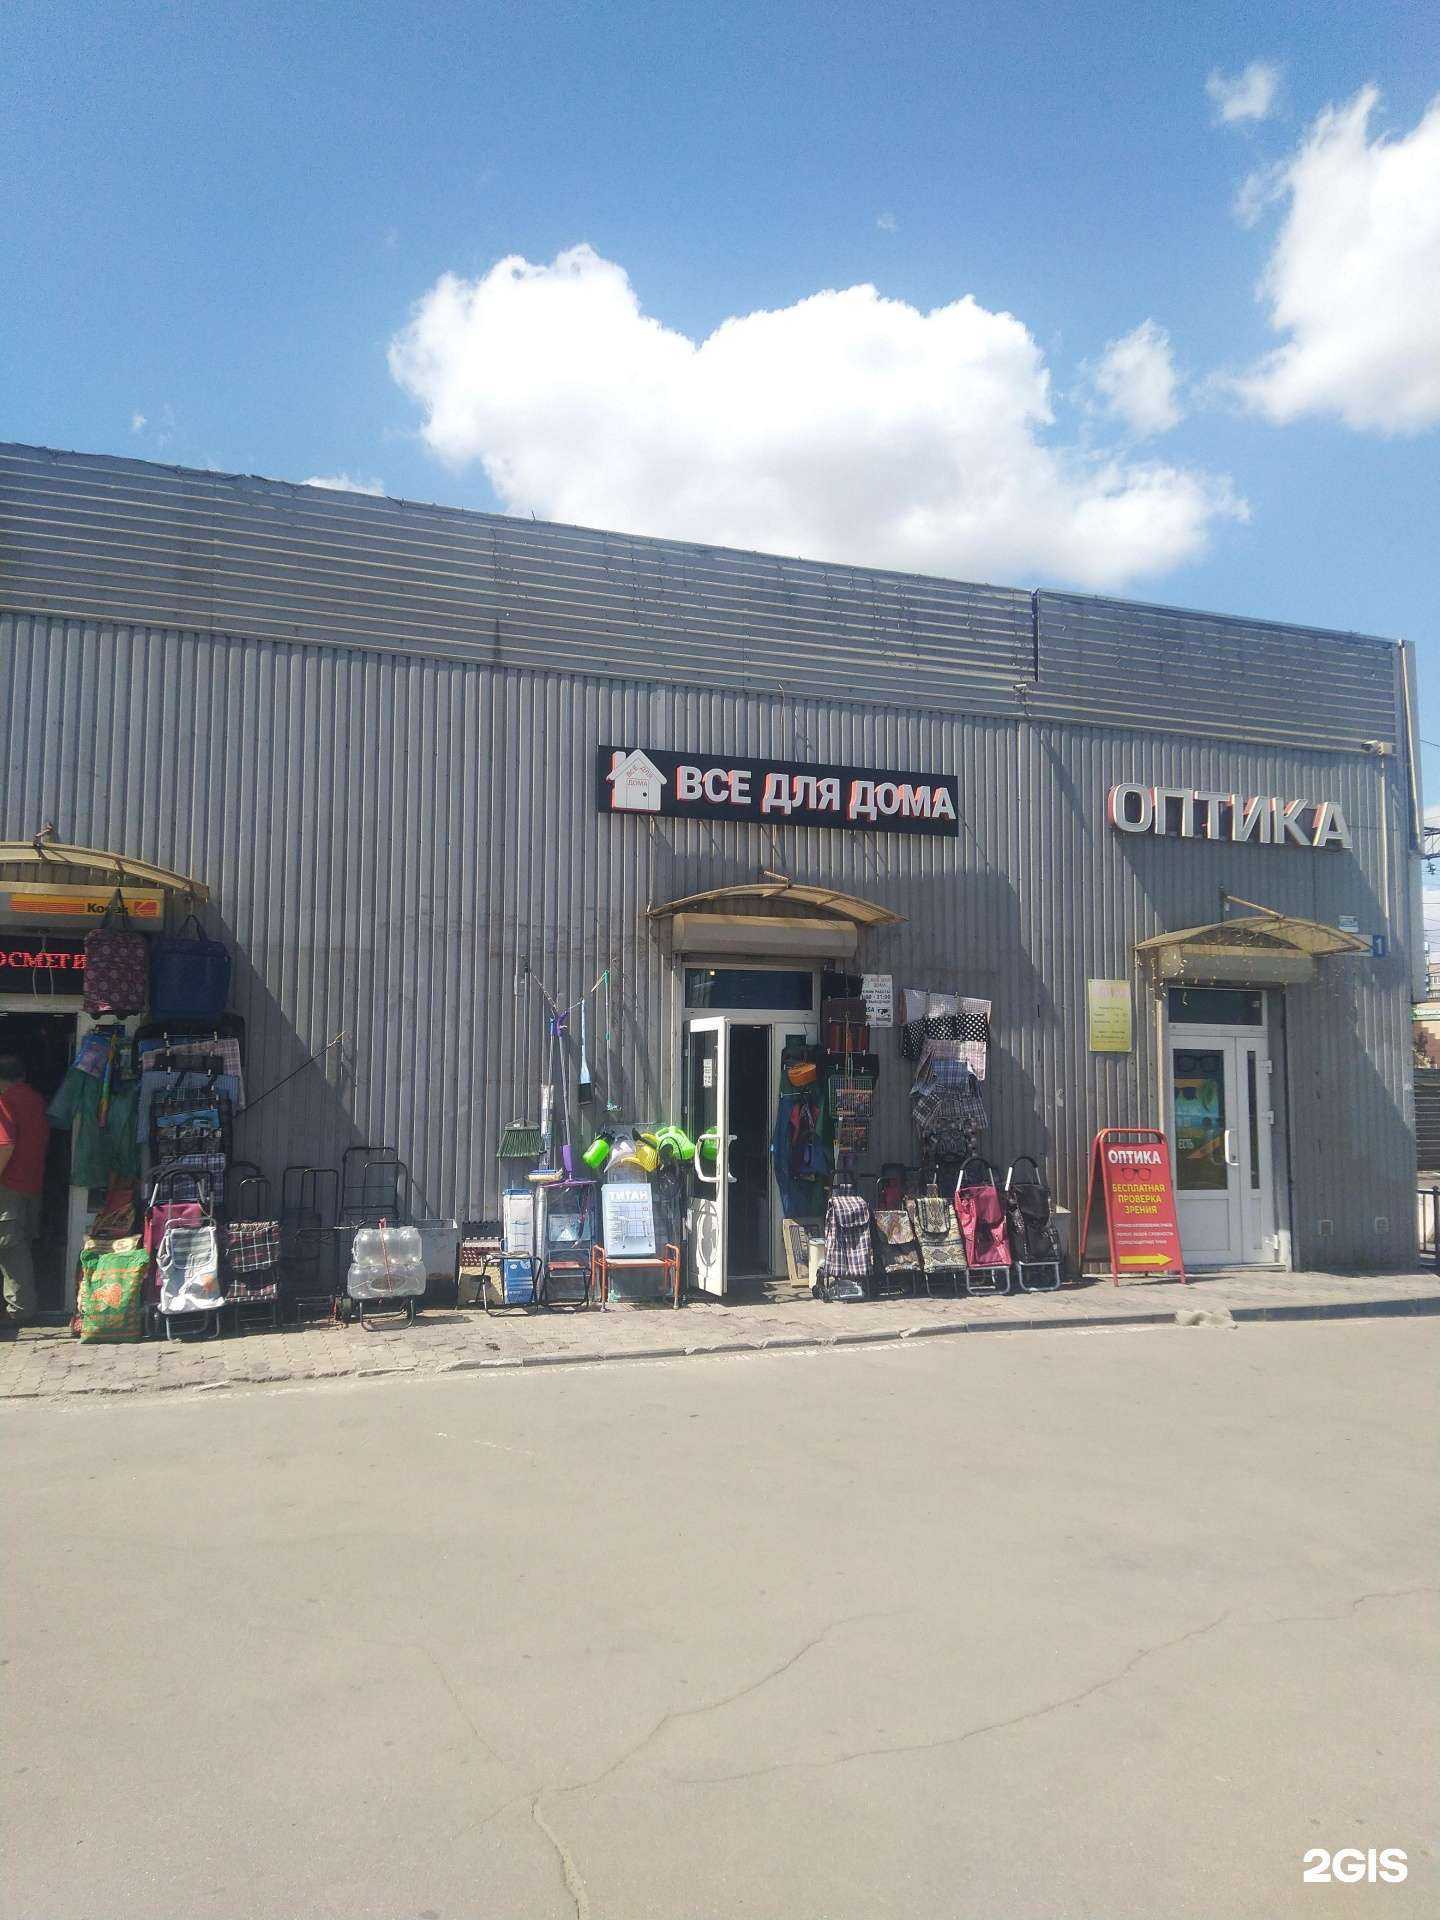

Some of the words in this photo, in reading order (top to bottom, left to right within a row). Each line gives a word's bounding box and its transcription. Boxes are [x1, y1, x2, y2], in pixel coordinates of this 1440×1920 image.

[676, 765, 752, 804] ВСЕ
[761, 772, 840, 815] ДЛЯ
[848, 779, 957, 821] ДОМА
[1108, 782, 1353, 849] ОПТИКА
[1375, 938, 1383, 954] 1
[1108, 1149, 1162, 1165] ОПТИКА
[1112, 1183, 1166, 1193] БЕСПЛАТНАЯ
[1118, 1194, 1162, 1204] ПРОВЕРКА
[1124, 1205, 1158, 1215] ЗРЕНИЯ
